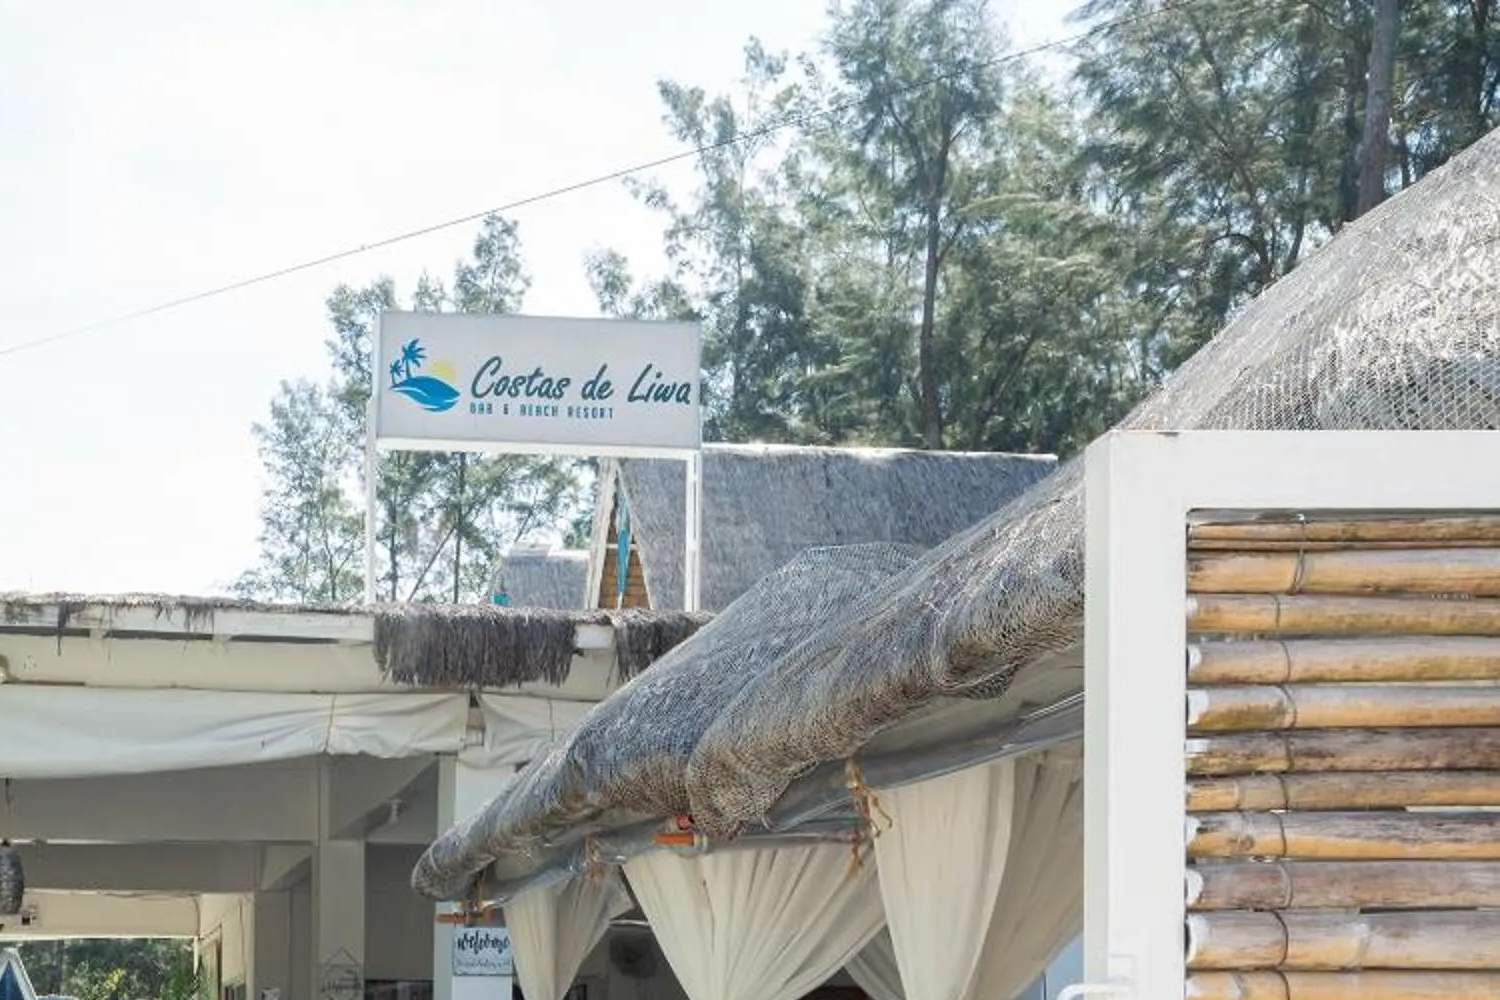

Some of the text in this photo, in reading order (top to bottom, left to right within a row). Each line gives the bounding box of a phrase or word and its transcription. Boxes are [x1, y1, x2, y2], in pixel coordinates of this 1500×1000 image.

[471, 356, 692, 404] Costas de Liwa
[470, 402, 614, 419] BAR & BEACH RESORT
